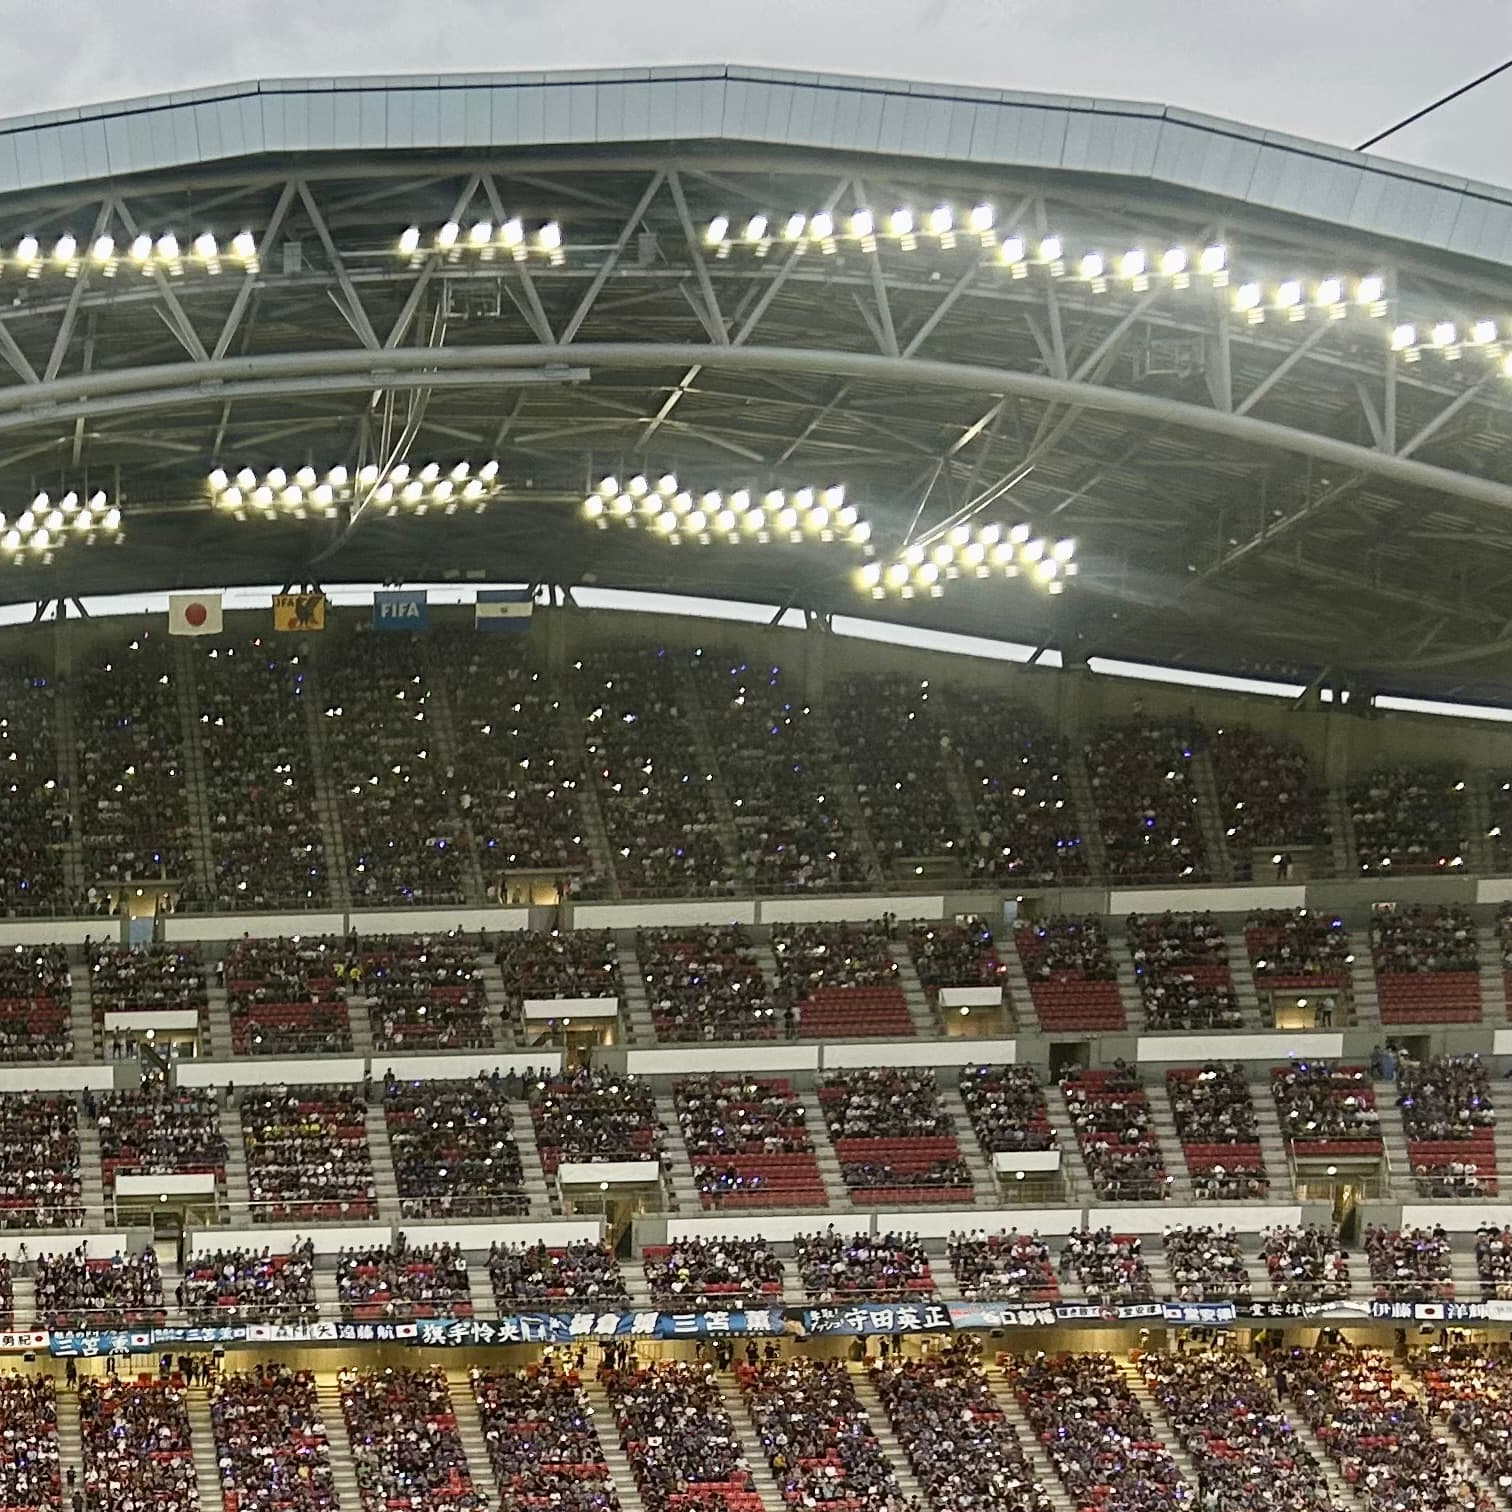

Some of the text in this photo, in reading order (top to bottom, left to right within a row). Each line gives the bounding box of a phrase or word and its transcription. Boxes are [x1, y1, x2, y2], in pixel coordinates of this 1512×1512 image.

[381, 602, 420, 618] FIFA
[844, 1306, 951, 1331] 守田英正
[422, 1320, 520, 1344] 旗手怜央
